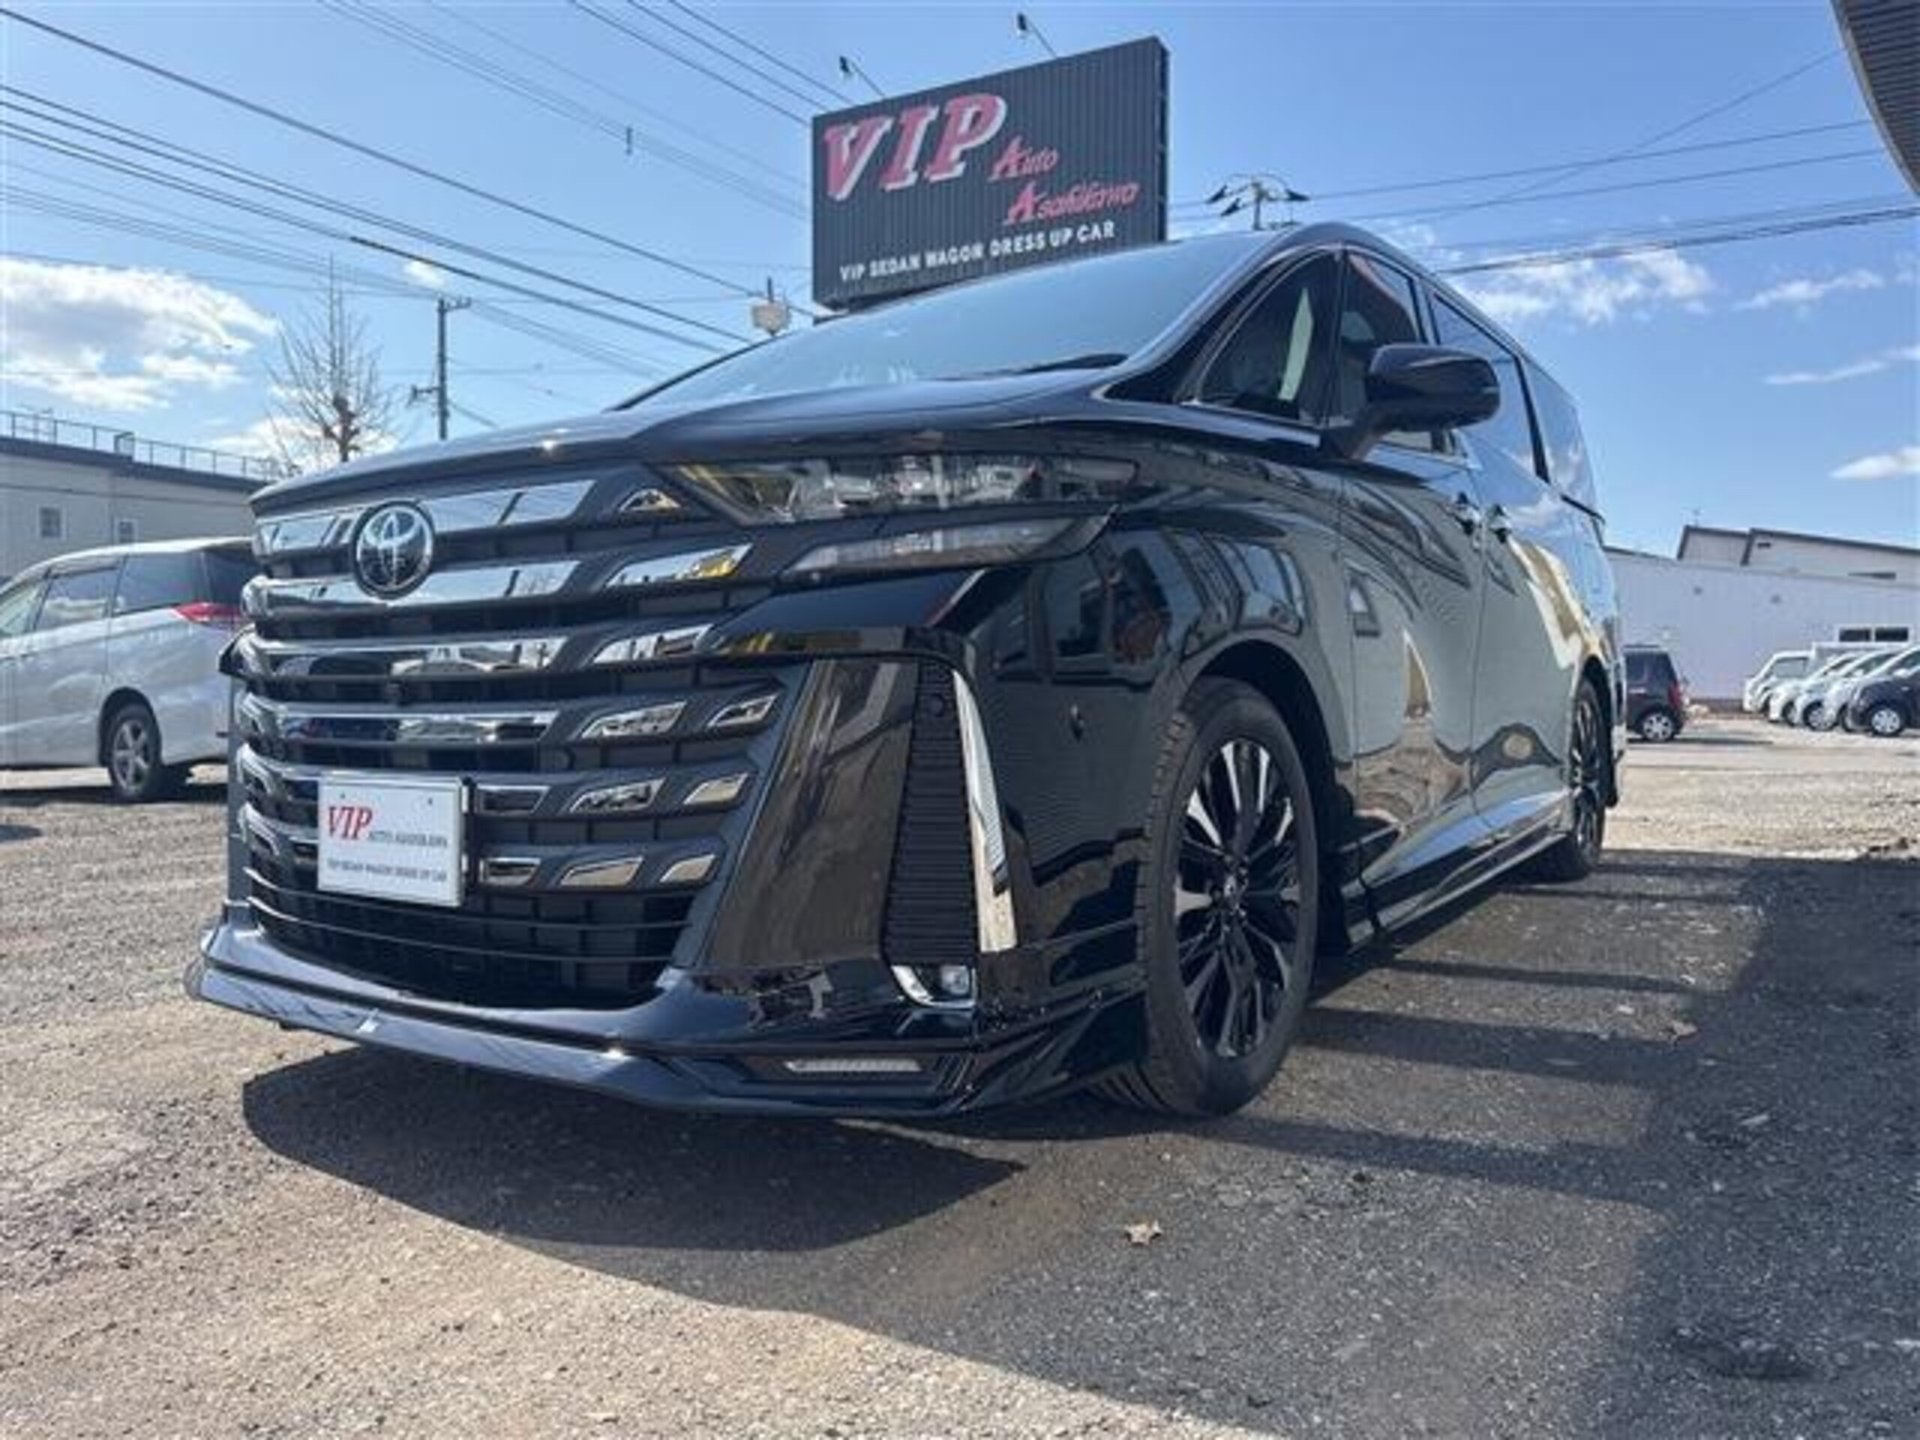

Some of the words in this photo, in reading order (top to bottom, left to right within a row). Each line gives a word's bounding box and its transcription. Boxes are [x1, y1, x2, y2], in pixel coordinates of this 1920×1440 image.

[824, 92, 1006, 202] VIP
[840, 263, 865, 282] VIP
[869, 252, 921, 278] SEDAN
[925, 242, 985, 268] WAGON
[989, 231, 1046, 256] DRESS
[1049, 226, 1073, 248] UP
[1077, 219, 1116, 243] CAR
[328, 805, 374, 841] VIP
